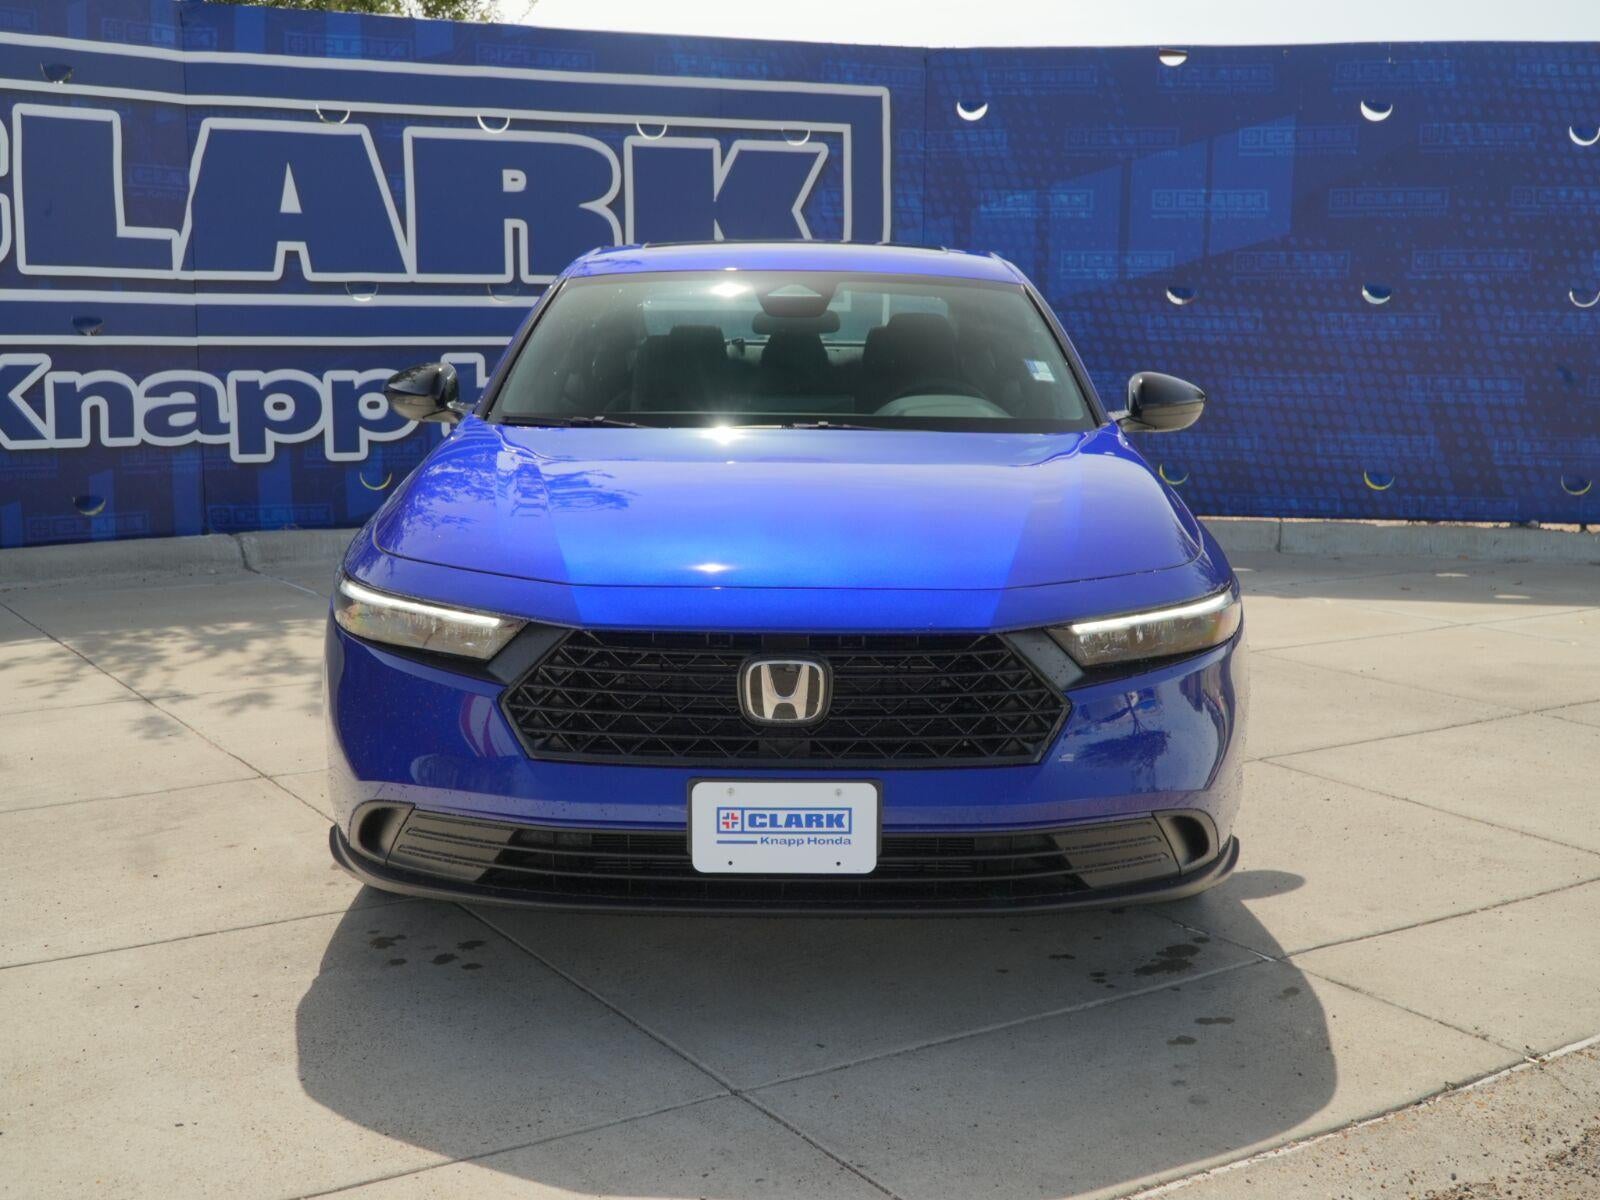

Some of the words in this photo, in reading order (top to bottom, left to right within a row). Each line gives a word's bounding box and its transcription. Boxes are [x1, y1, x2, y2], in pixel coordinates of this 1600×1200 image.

[0, 102, 829, 284] LARK
[747, 813, 846, 829] CLARK
[760, 836, 805, 847] Knapp
[807, 836, 852, 846] Honda
